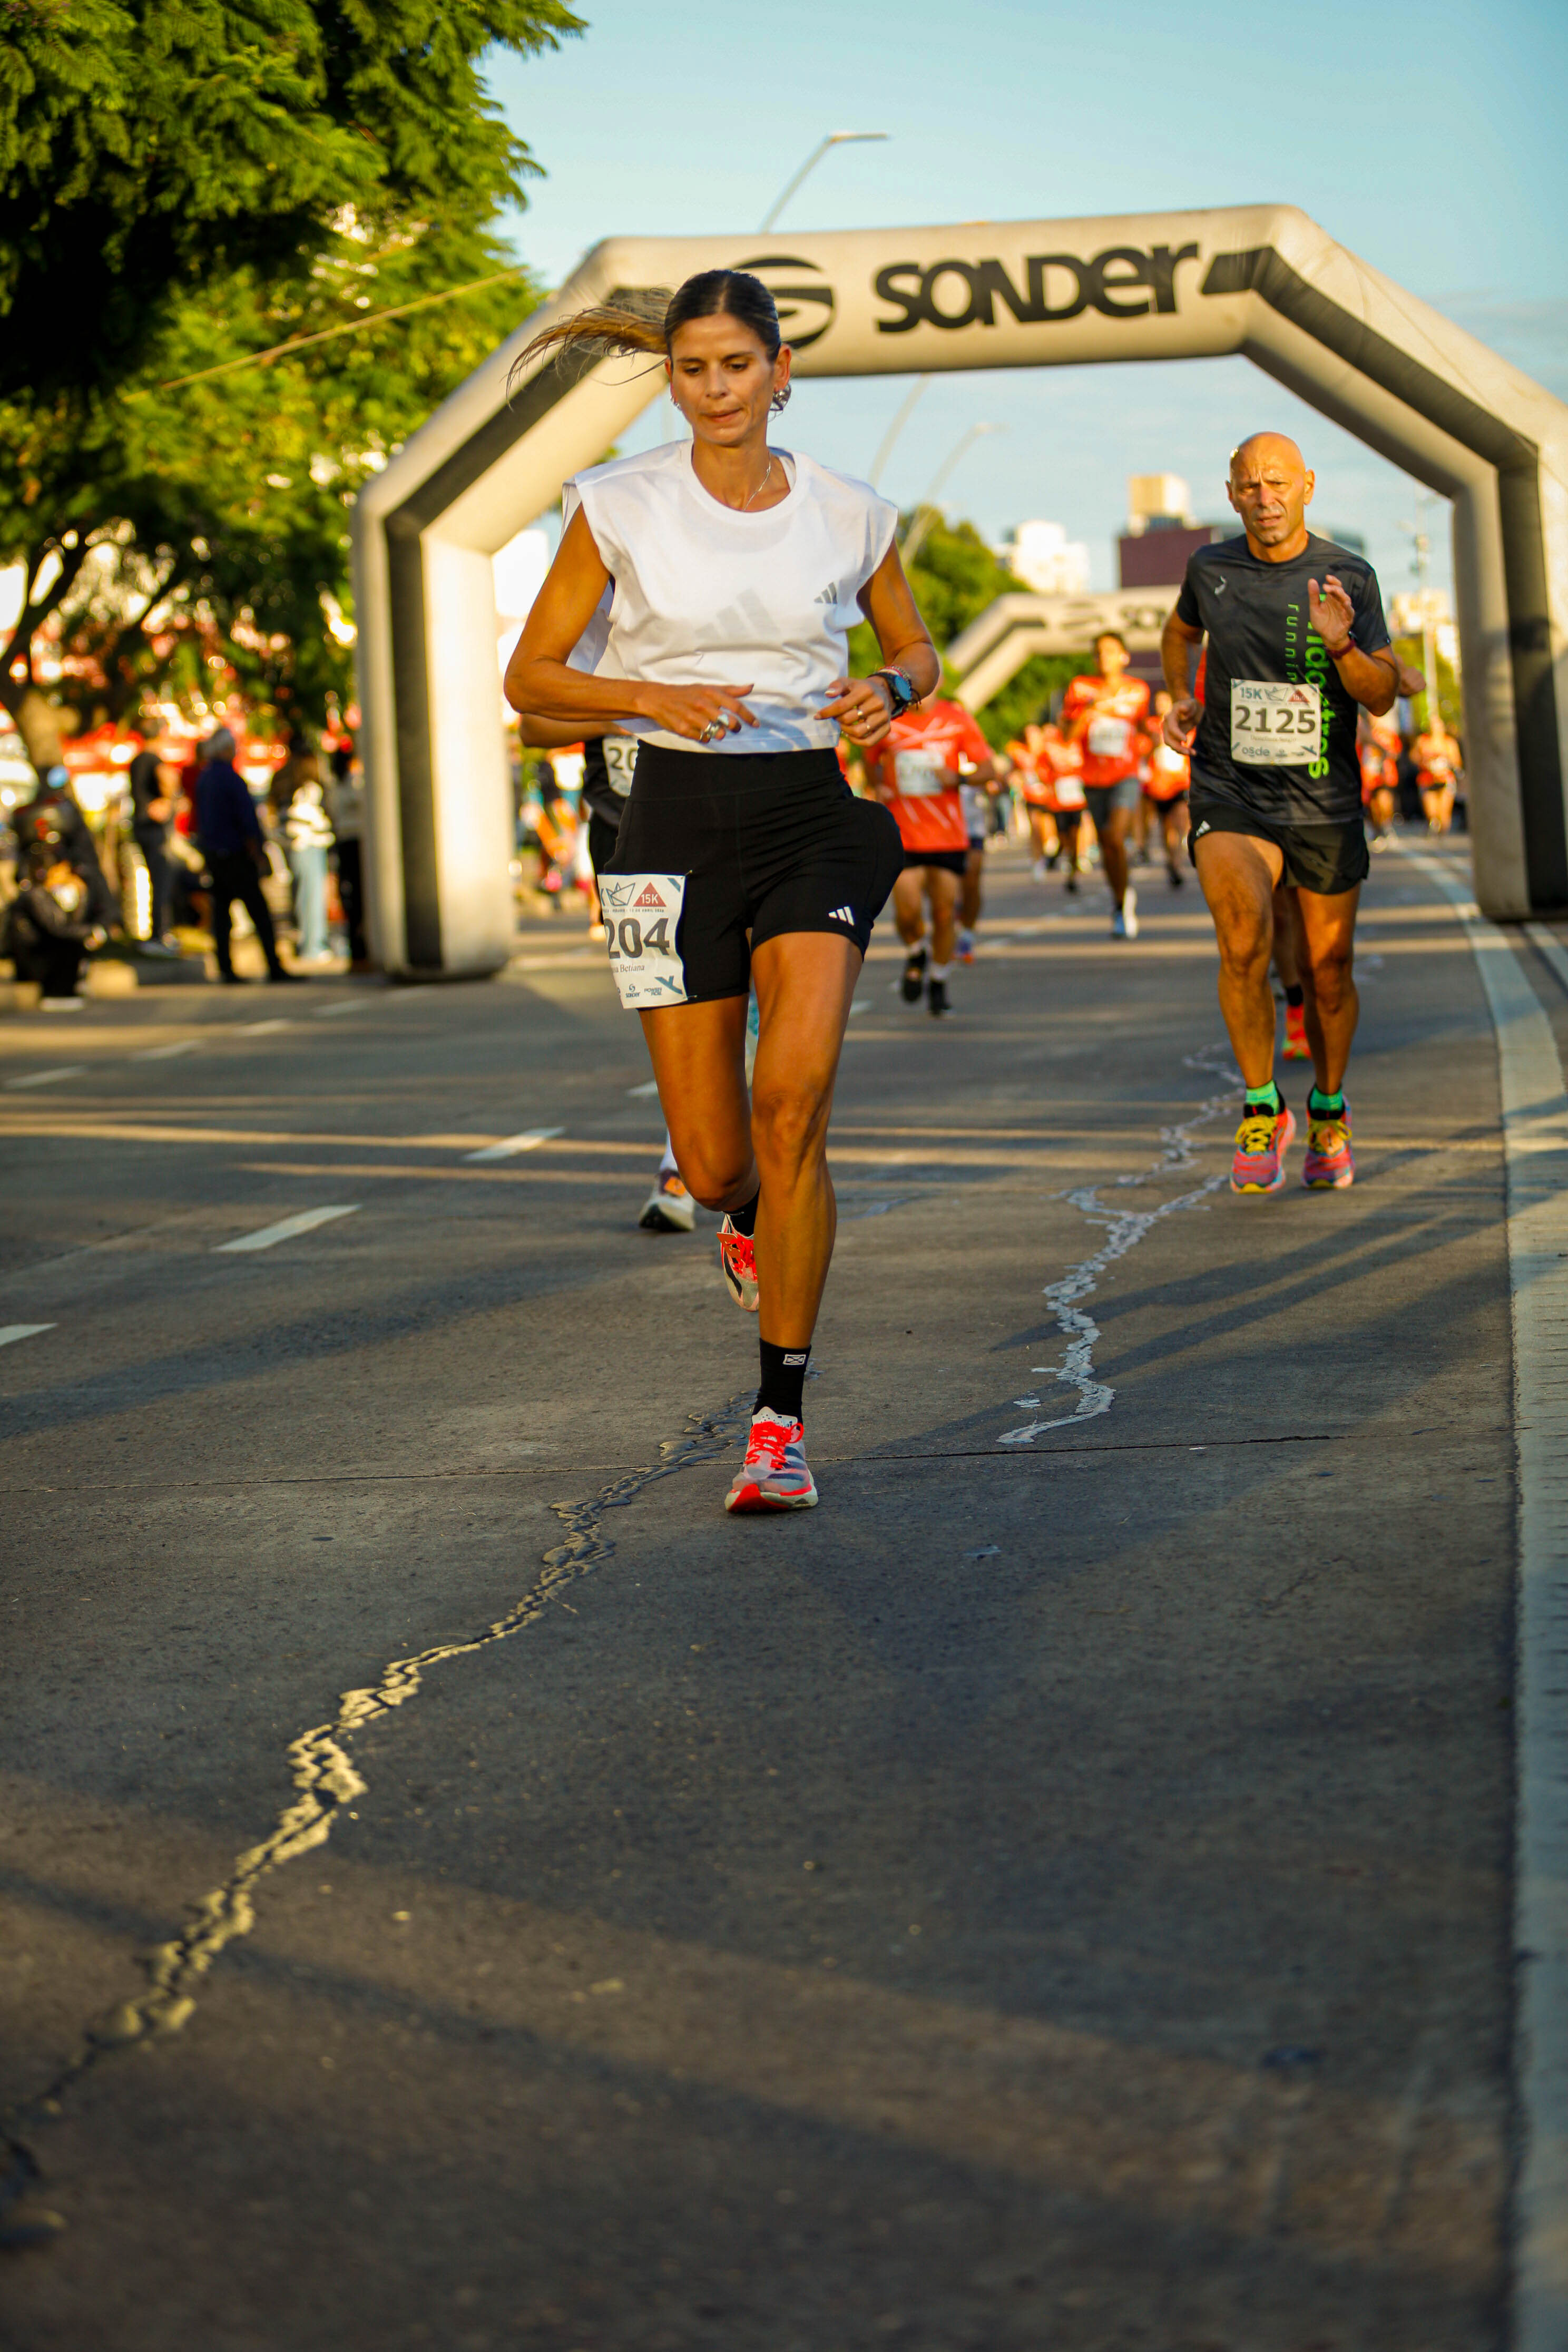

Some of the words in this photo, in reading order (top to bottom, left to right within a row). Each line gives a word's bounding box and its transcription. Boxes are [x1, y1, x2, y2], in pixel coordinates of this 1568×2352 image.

[1285, 603, 1300, 682] runnin
[1240, 687, 1262, 700] 15K
[1234, 704, 1316, 733] 2125
[1242, 747, 1270, 757] osde
[641, 894, 658, 904] 15K
[620, 964, 645, 973] Betiana
